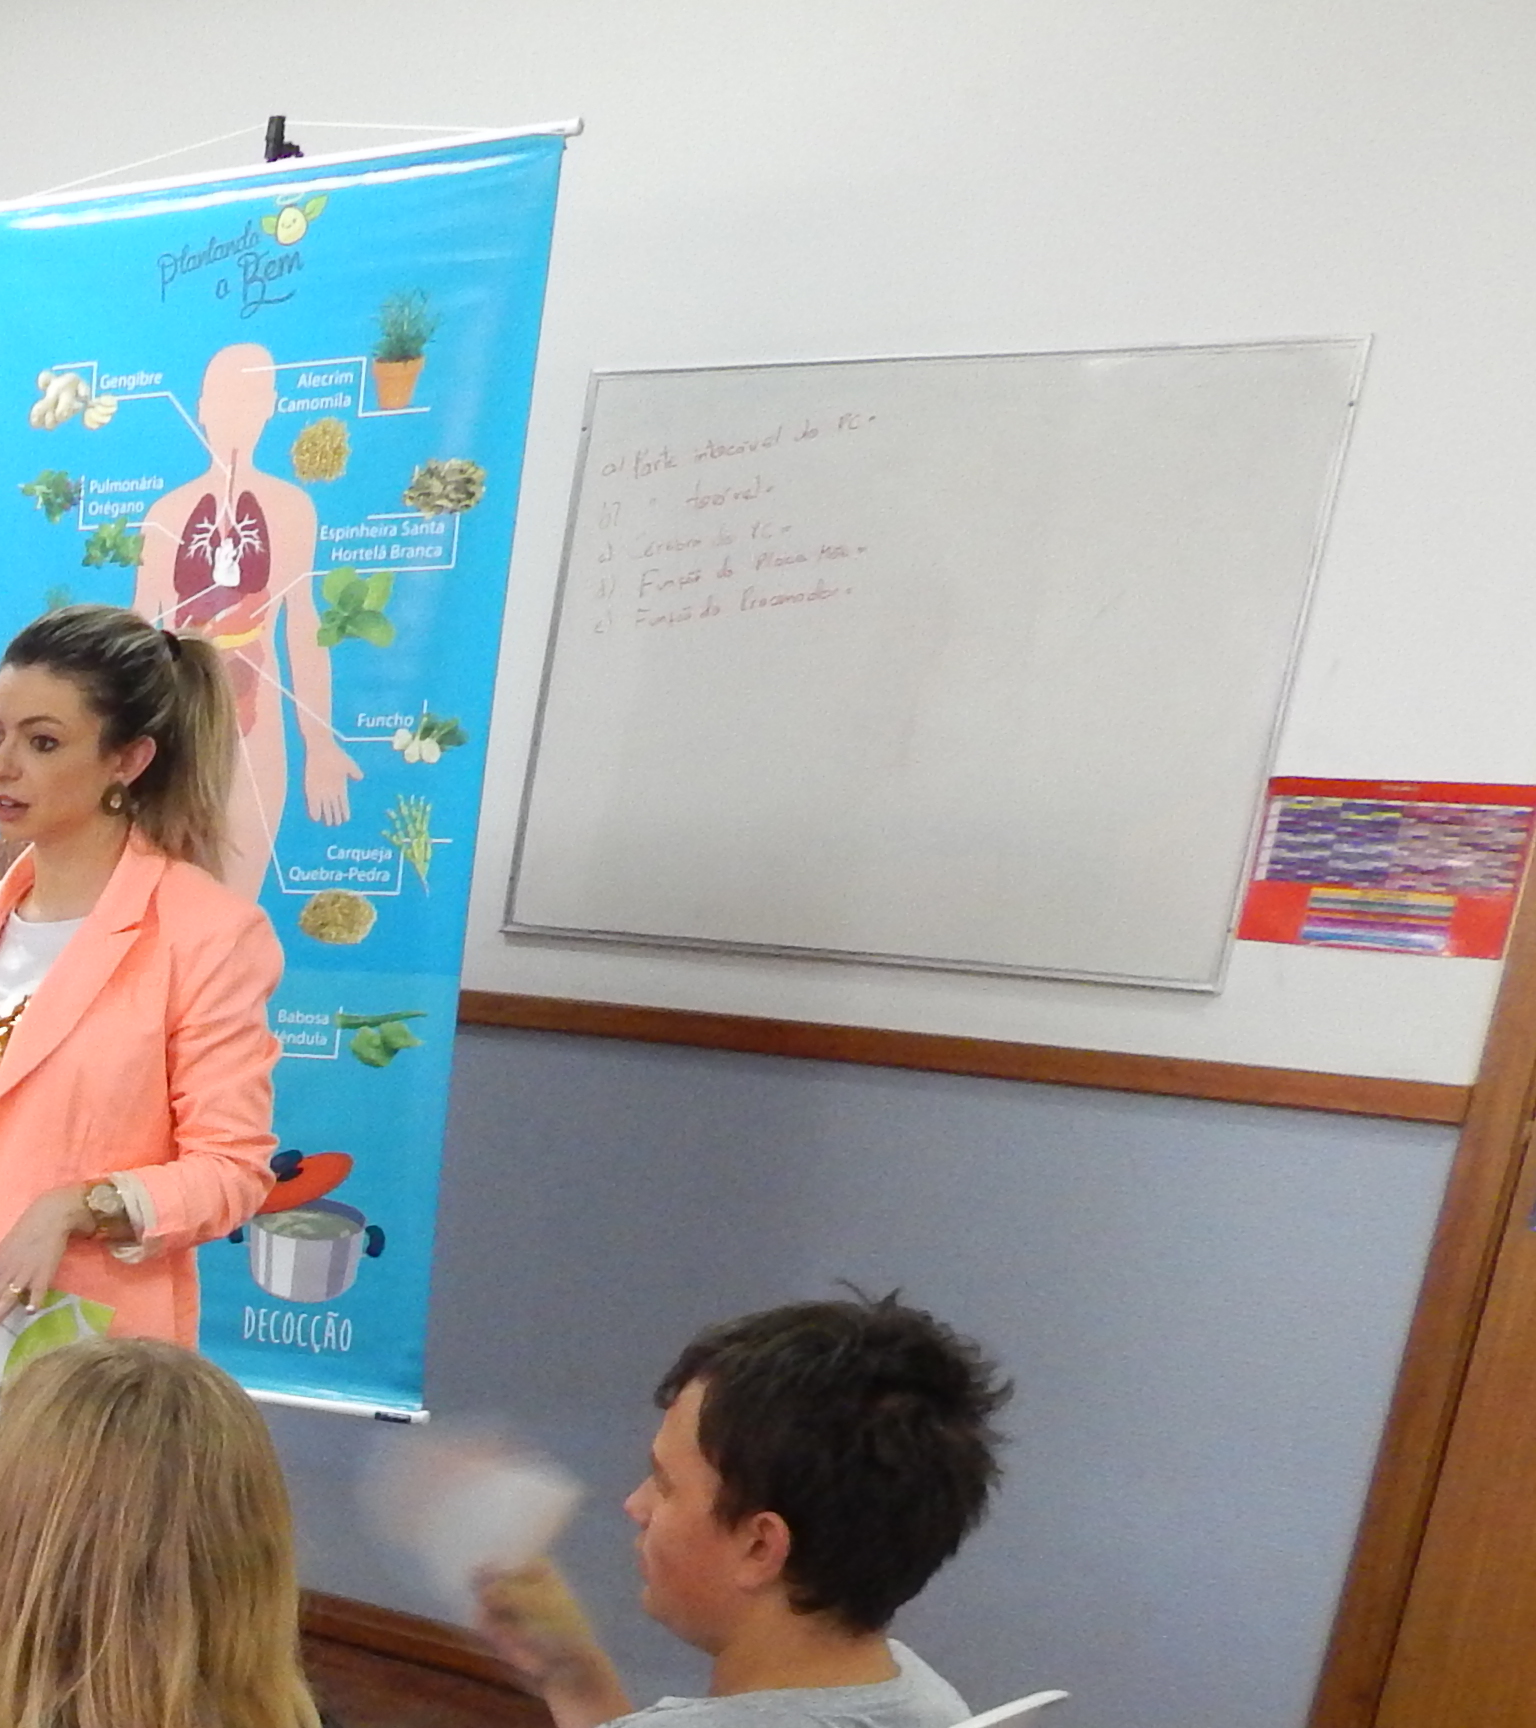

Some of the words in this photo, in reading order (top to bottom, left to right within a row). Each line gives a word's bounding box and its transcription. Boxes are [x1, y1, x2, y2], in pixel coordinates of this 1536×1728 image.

[237, 250, 304, 320] Bem
[100, 369, 164, 393] Gengibre
[297, 370, 354, 389] Alecrim
[278, 393, 352, 413] Camomila
[89, 475, 165, 494] Pulmonária
[88, 500, 145, 519] Orégano
[320, 524, 398, 542] Espinheira
[402, 520, 445, 537] Santa
[331, 545, 387, 562] Hortelã
[390, 544, 443, 560] Branca
[357, 713, 415, 728] Funcho
[326, 845, 393, 862] Carqueja
[289, 867, 391, 882] Quebra-Pedra
[278, 1009, 329, 1025] Babosa
[244, 1305, 353, 1353] DECOCÇÃO
